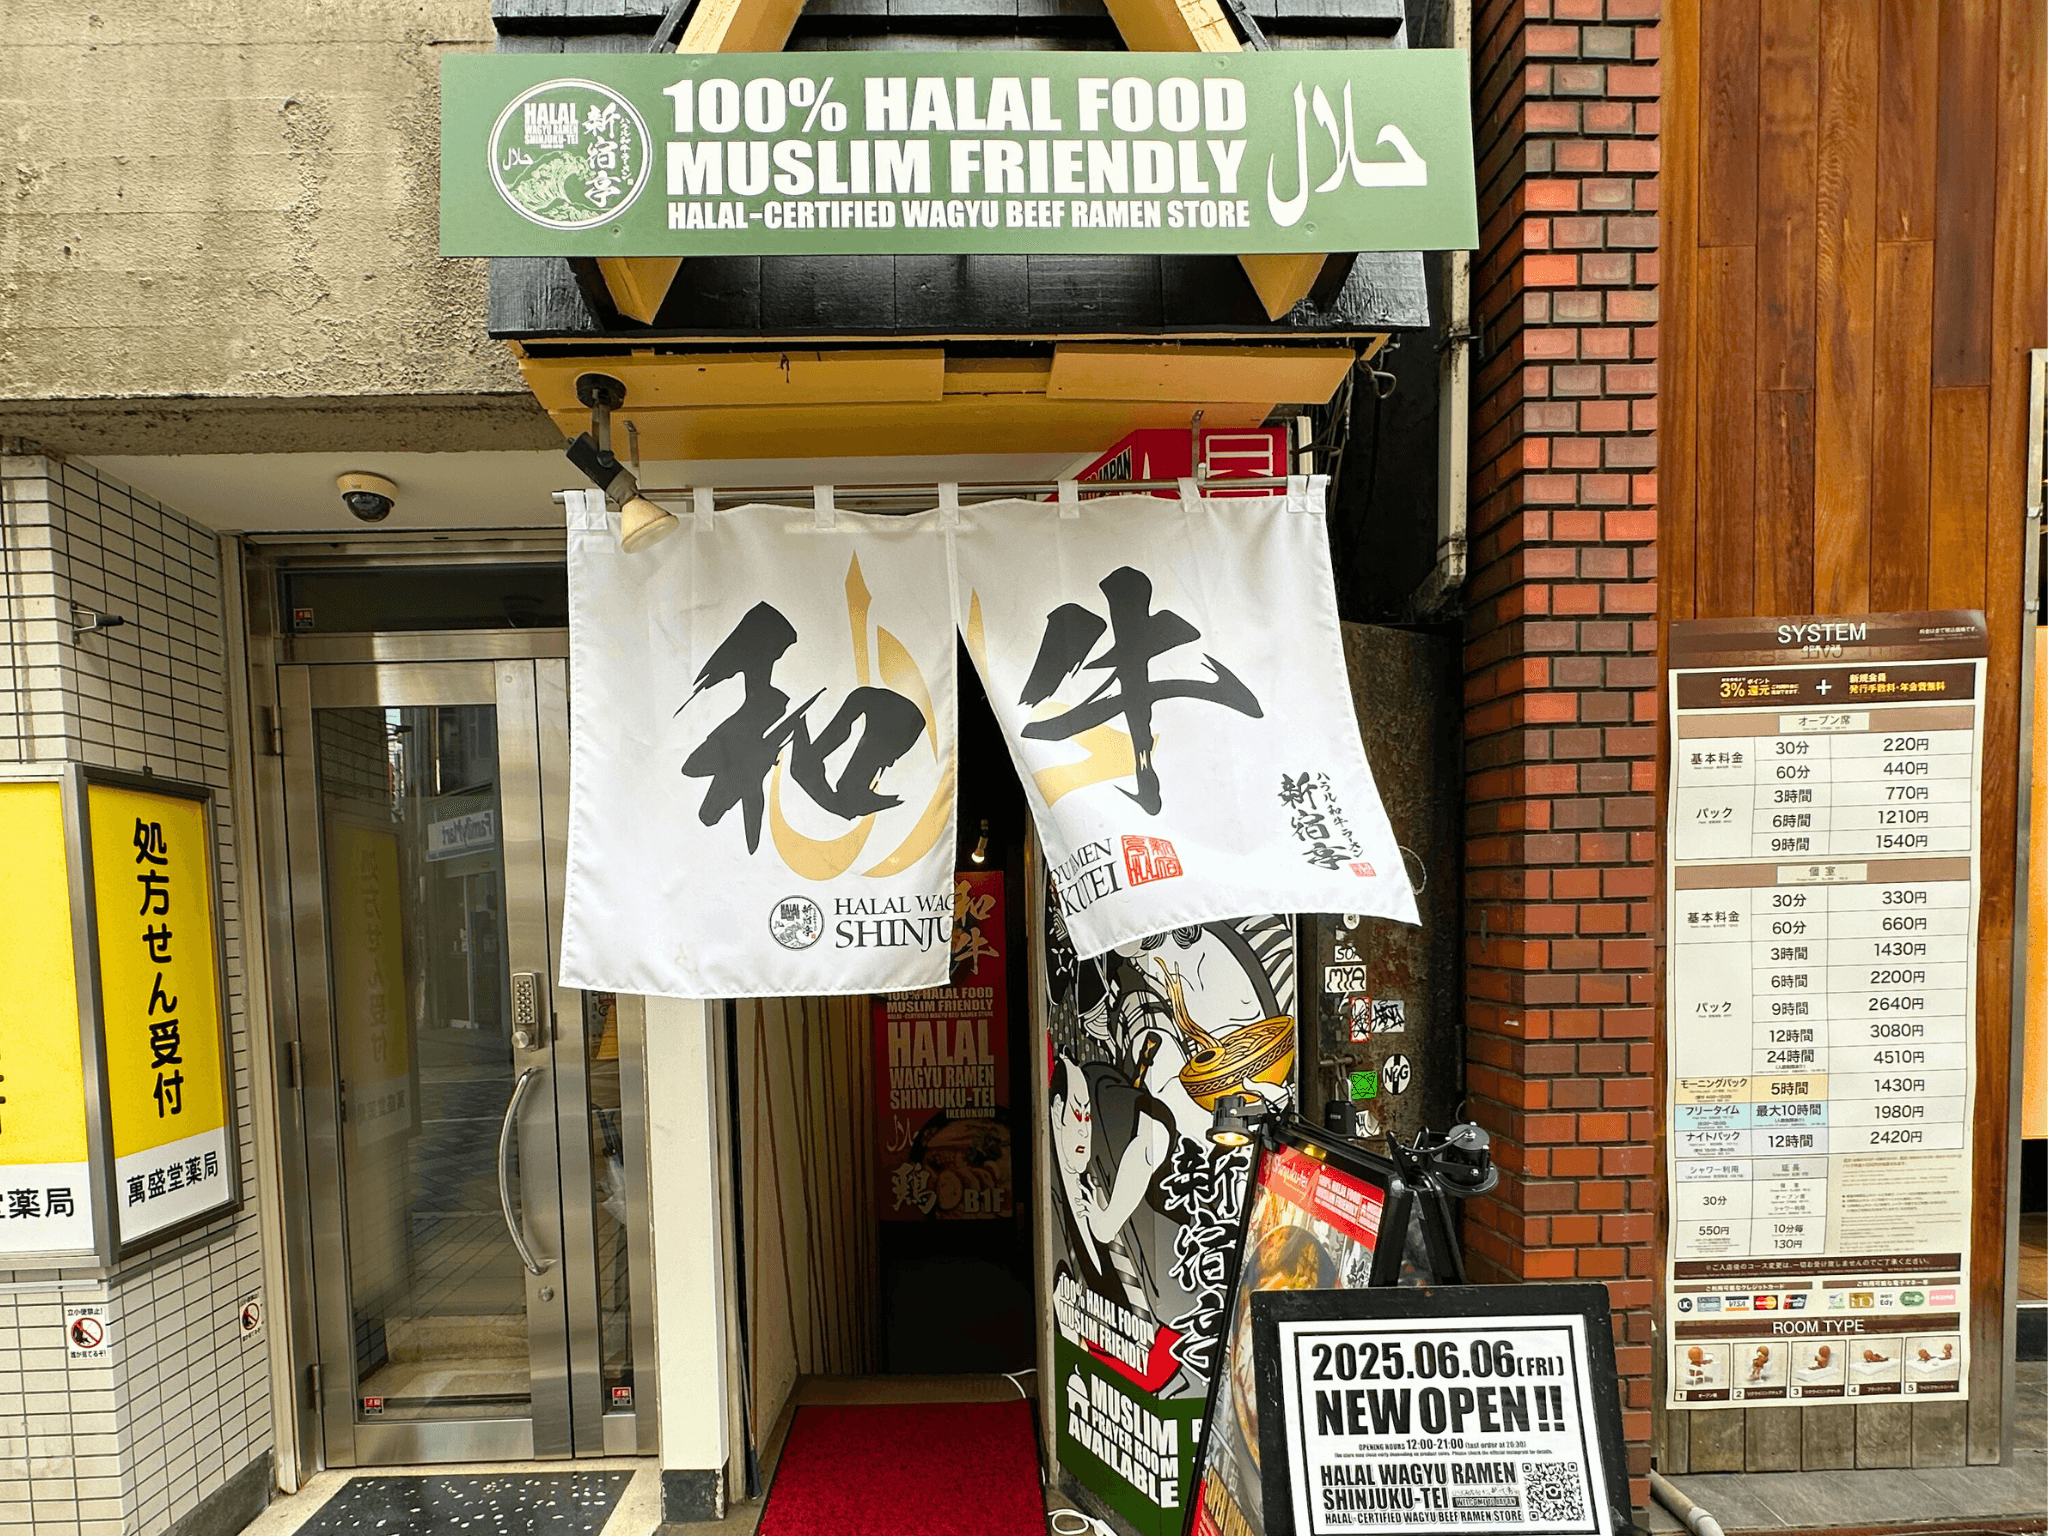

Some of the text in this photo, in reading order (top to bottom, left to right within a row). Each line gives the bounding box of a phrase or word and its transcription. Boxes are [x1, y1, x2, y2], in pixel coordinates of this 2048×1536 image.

[662, 76, 1247, 133] 100% HALAL FOOD
[524, 103, 578, 125] HALAL
[582, 102, 621, 208] 新宿亭
[1267, 79, 1428, 227] حلال
[666, 139, 1247, 196] MUSLIM FRIENDLY
[668, 200, 1250, 229] HALAL-CERTIFIED WAGYU BEEF RAMEN STORE
[1777, 622, 1867, 644] SYSTEM
[1720, 682, 1746, 698] 3%
[1747, 685, 1770, 696] 還元
[1775, 742, 1810, 755] 30分
[1883, 738, 1929, 751] 220円
[1691, 752, 1743, 765] 基本料金
[1776, 766, 1810, 779] 60分
[1883, 762, 1929, 775] 440円
[1773, 789, 1812, 803] 3時間
[1885, 786, 1928, 800] 770円
[1696, 807, 1733, 819] パック
[1877, 810, 1928, 824] 1210円
[1278, 771, 1351, 870] 新宿亭
[1772, 813, 1811, 828] 6時間
[1771, 837, 1810, 852] 9時間
[1875, 834, 1928, 848] 1540円
[1772, 894, 1807, 907] 30分
[1882, 891, 1927, 905] 330円
[834, 897, 911, 915] HALAL
[1687, 910, 1740, 924] 基本料金
[1882, 917, 1927, 930] 660円
[1772, 921, 1807, 934] 60分
[1770, 946, 1808, 961] 3時間
[1873, 942, 1926, 956] 1430円
[133, 817, 185, 1118] 処方せん受付
[1771, 974, 1808, 988] 6時間
[1870, 970, 1925, 984] 2200円
[962, 986, 994, 999] FOOD
[887, 998, 994, 1013] MUSLIM FRIENDLY
[1696, 1001, 1732, 1013] パック
[1771, 1002, 1809, 1016] 9時間
[1868, 997, 1924, 1011] 2640円
[1769, 1028, 1814, 1043] 12時間
[1870, 1023, 1924, 1038] 3080円
[888, 1019, 994, 1067] HALAL
[1767, 1049, 1814, 1063] 24時間
[1873, 1050, 1925, 1064] 4510円
[889, 1065, 995, 1089] WAGYU RAMEN
[1771, 1082, 1808, 1096] 5時間
[1874, 1078, 1925, 1092] 1430円
[890, 1087, 995, 1109] SHINJUKU-TEI
[1685, 1105, 1740, 1115] フリータイム
[1756, 1104, 1822, 1117] 最大10時間
[1874, 1105, 1924, 1119] 1980円
[1686, 1131, 1740, 1142] ナイトパック
[1768, 1134, 1813, 1148] 12時間
[1870, 1131, 1923, 1145] 2420円
[127, 1151, 219, 1208] 萬盛堂薬局
[964, 1188, 1006, 1213] B1F
[1703, 1195, 1728, 1206] 30分
[1699, 1225, 1730, 1235] 550円
[1774, 1224, 1804, 1233] 10分毎
[1774, 1239, 1803, 1249] 130円
[1058, 1275, 1148, 1346] 100% HALAL FOOD
[1773, 1319, 1865, 1335] ROOM TYPE
[1059, 1299, 1149, 1377] MUSLIM FRIENDLY
[1736, 1390, 1742, 1398] 2
[1090, 1373, 1178, 1456] MUSLIM
[1315, 1388, 1412, 1436] NEW
[1092, 1407, 1133, 1455] PRAYER
[1134, 1438, 1179, 1479] ROOM
[1406, 1438, 1464, 1450] 12:00-21:00
[1068, 1411, 1180, 1509] AVAILABLE
[1320, 1462, 1517, 1487] HALAL WAGYU RAMEN
[1323, 1487, 1449, 1511] SHINJUKU-TEI
[1403, 1512, 1437, 1524] WAGYU
[1438, 1511, 1459, 1523] BEEF
[1460, 1511, 1493, 1523] RAMEN
[1494, 1510, 1523, 1523] STORE
